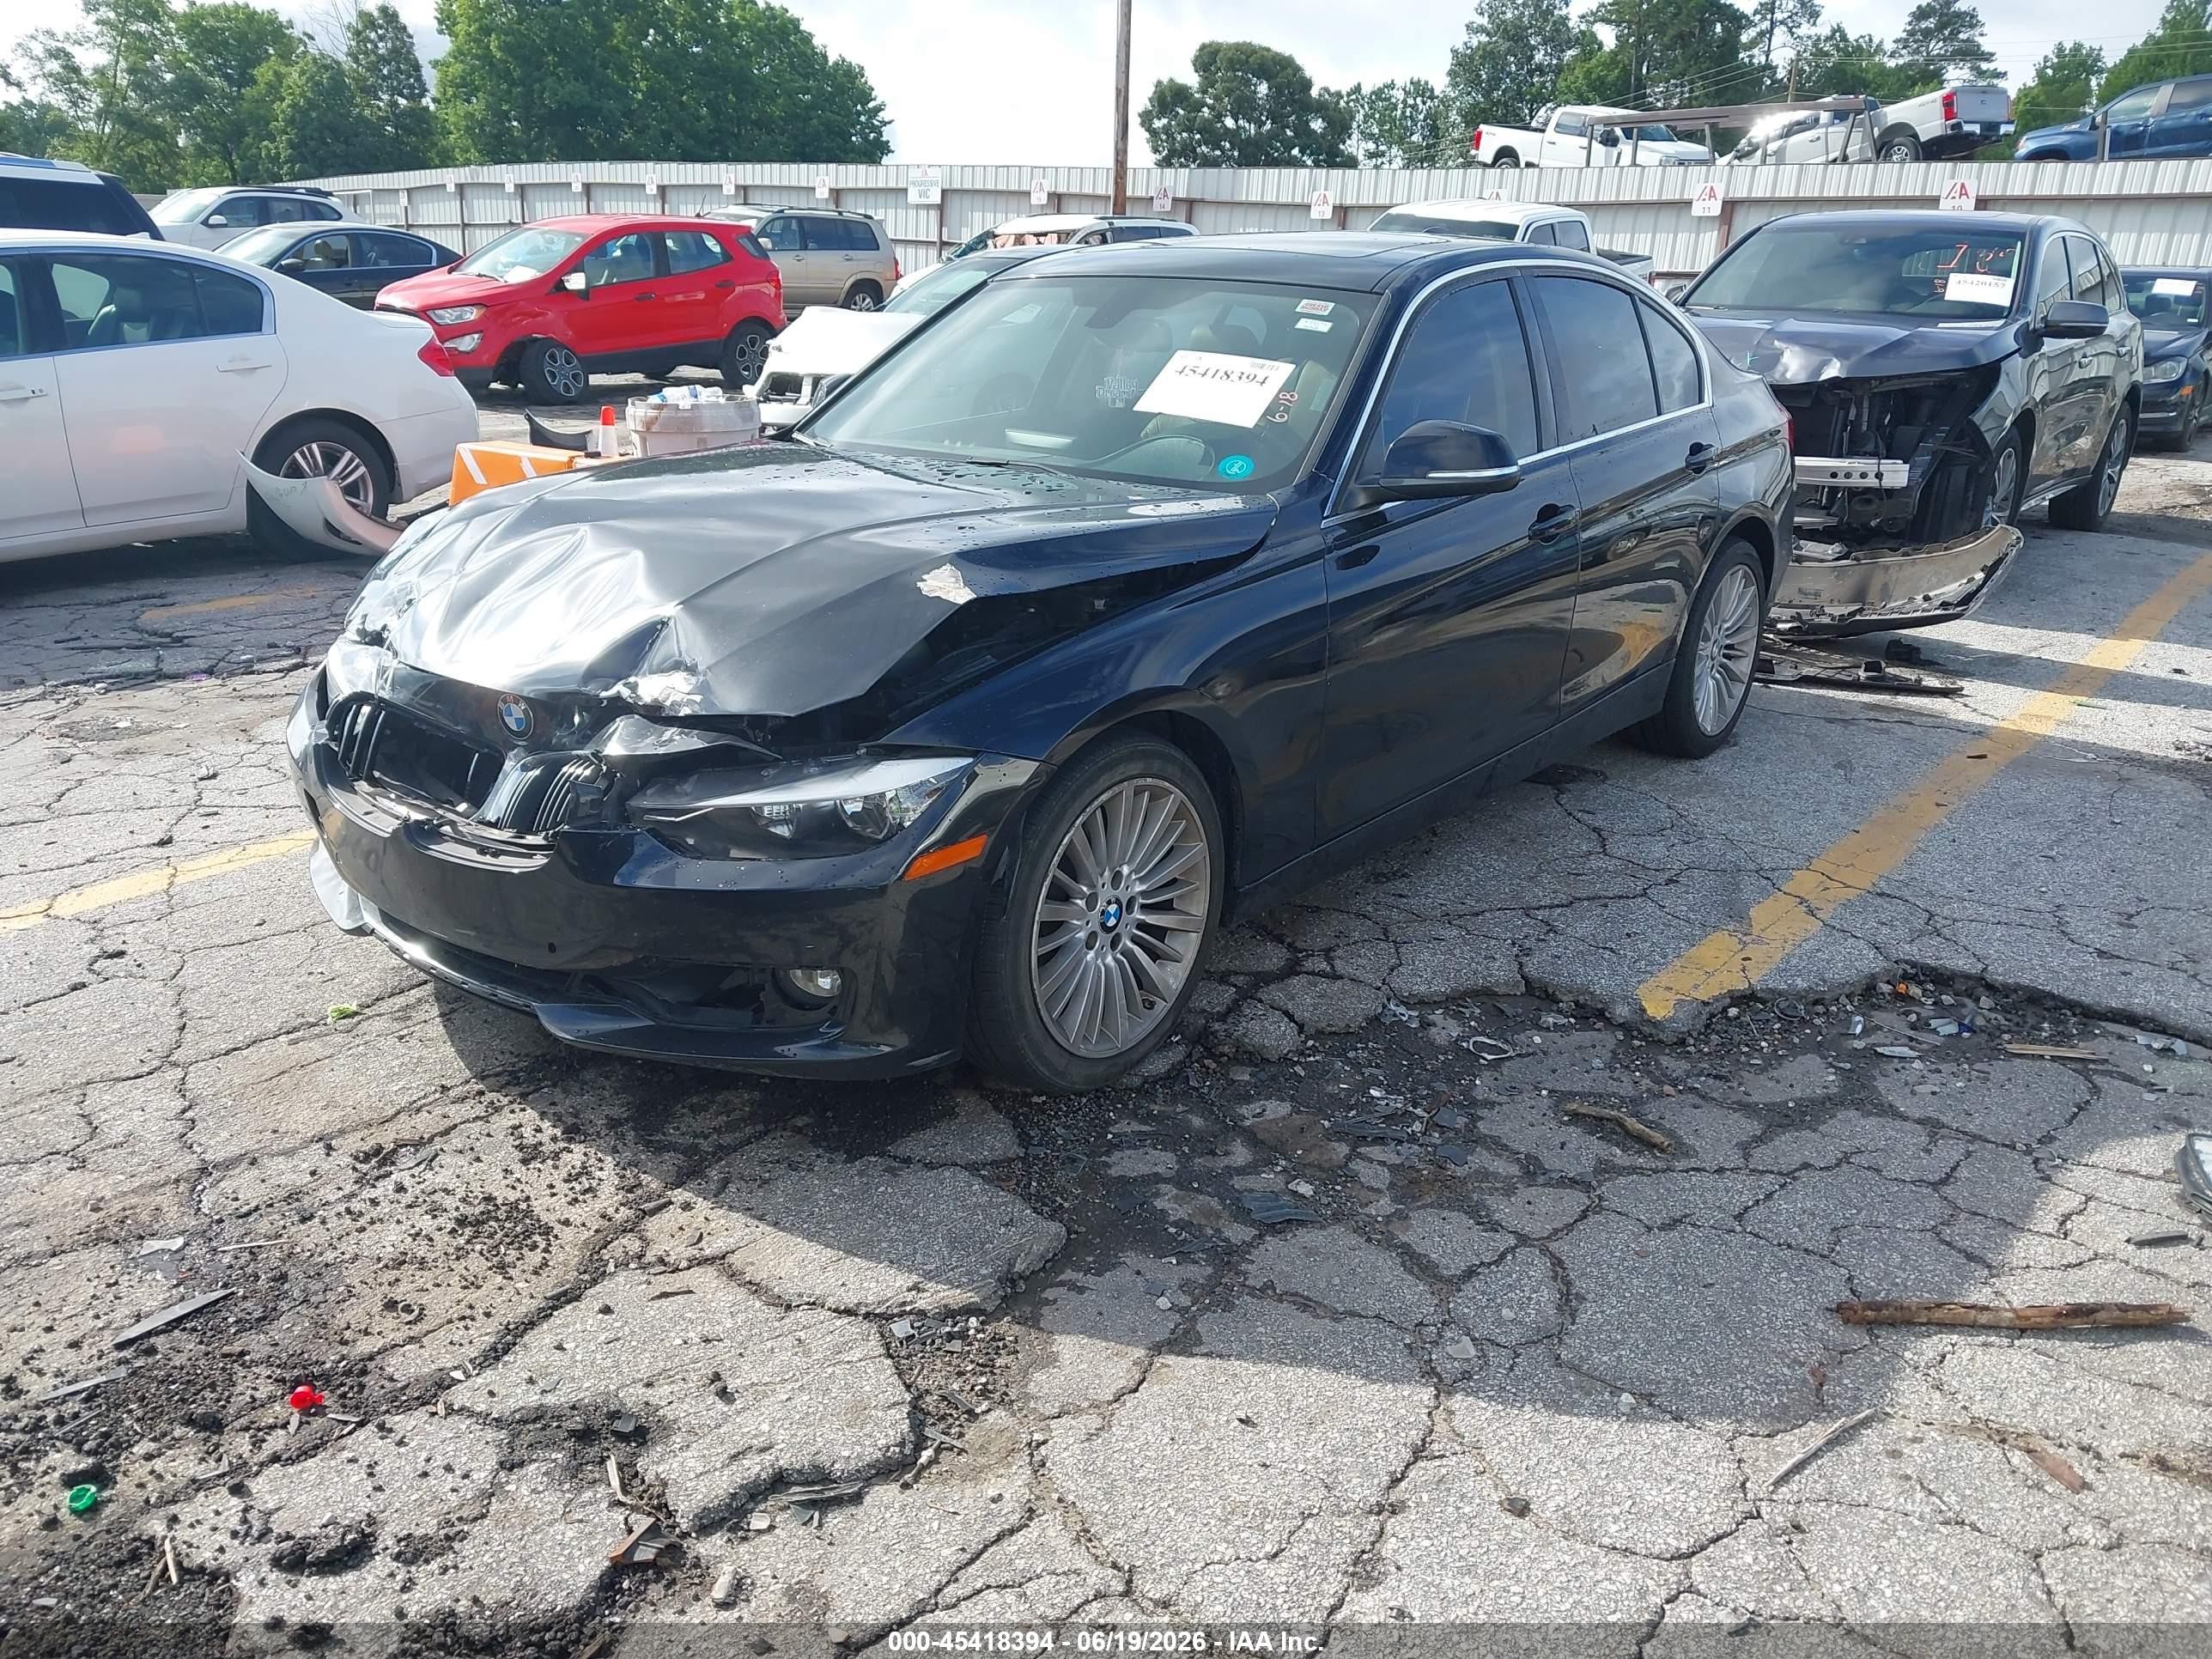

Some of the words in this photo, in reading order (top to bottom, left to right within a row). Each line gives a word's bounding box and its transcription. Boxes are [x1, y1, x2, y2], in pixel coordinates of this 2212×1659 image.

[918, 188, 931, 199] VIC
[1104, 377, 1139, 392] Valley
[1175, 365, 1270, 386] 45418394
[1266, 392, 1298, 423] 6-18
